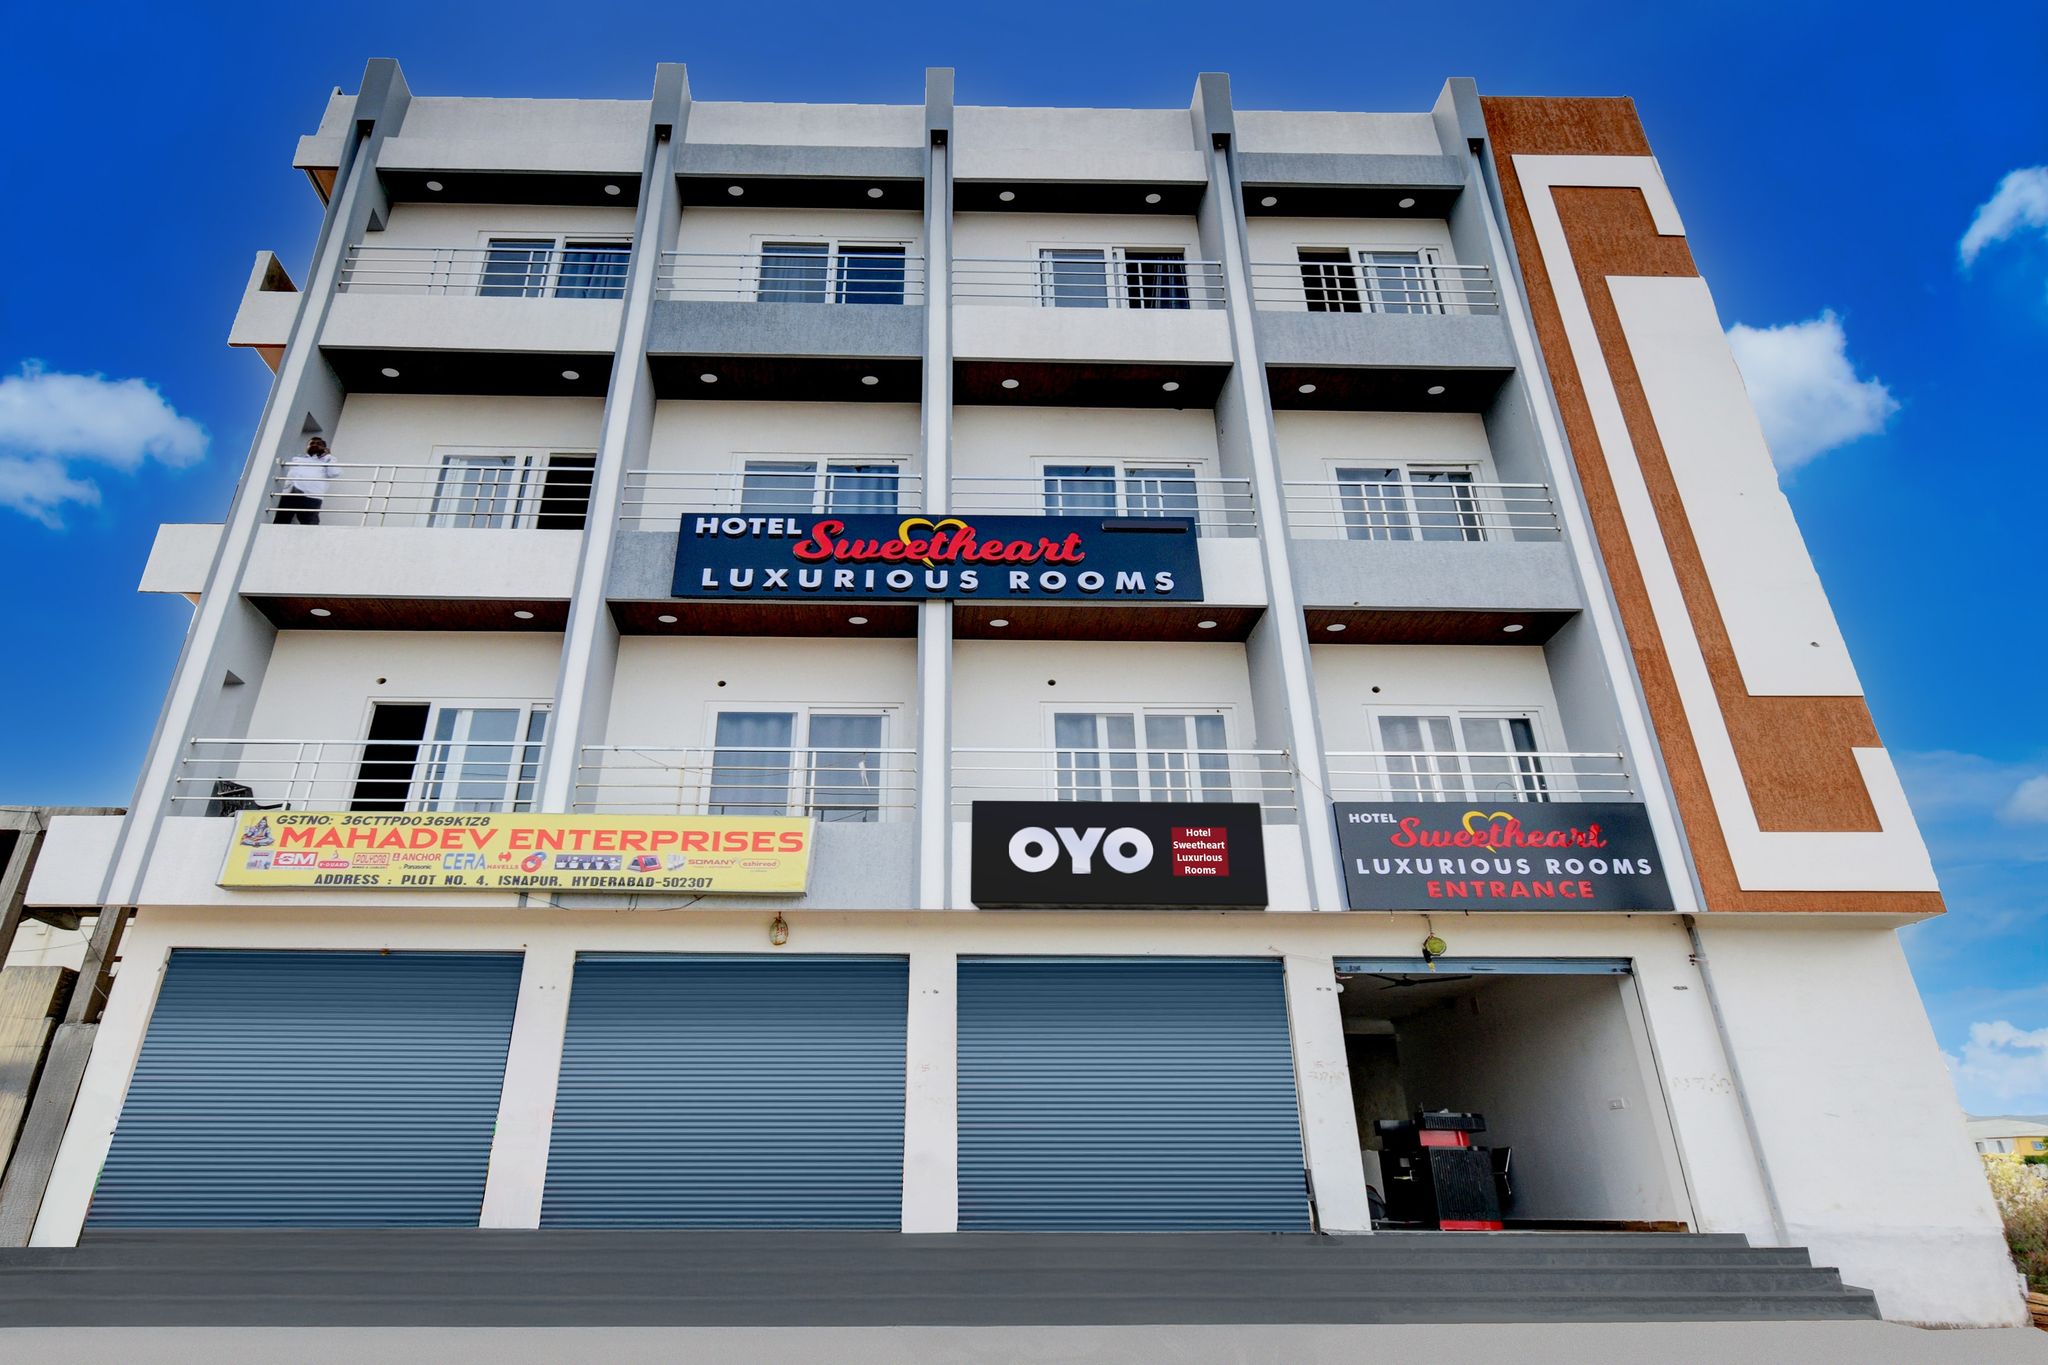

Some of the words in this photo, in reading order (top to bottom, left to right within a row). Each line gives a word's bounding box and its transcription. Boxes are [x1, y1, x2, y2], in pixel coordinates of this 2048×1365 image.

[695, 517, 802, 536] HOTEL
[792, 519, 1086, 565] Sweetheart
[701, 568, 979, 592] LUXURIOUS
[1009, 570, 1176, 593] ROOMS
[276, 815, 334, 826] GSTNO:
[279, 826, 498, 850] MAHADEV
[508, 828, 804, 853] ENTERPRISES
[1185, 828, 1211, 837] Hotel
[1349, 813, 1397, 824] HOTEL
[1390, 816, 1608, 849] Sweetheart
[1008, 826, 1154, 875] OYO
[1173, 840, 1226, 850] Sweetheart
[402, 853, 441, 861] ANCHOR
[442, 853, 486, 870] CERA
[1176, 853, 1223, 862] Luxurious
[1184, 866, 1217, 875] Rooms
[1356, 858, 1531, 875] LUXURIOUS
[1547, 859, 1653, 875] ROOMS
[314, 874, 380, 885] ADDRESS
[401, 874, 437, 885] PLOT
[444, 875, 467, 886] NO.
[571, 876, 714, 888] HYDERABAD-502307
[1427, 880, 1595, 899] ENTRANCE
